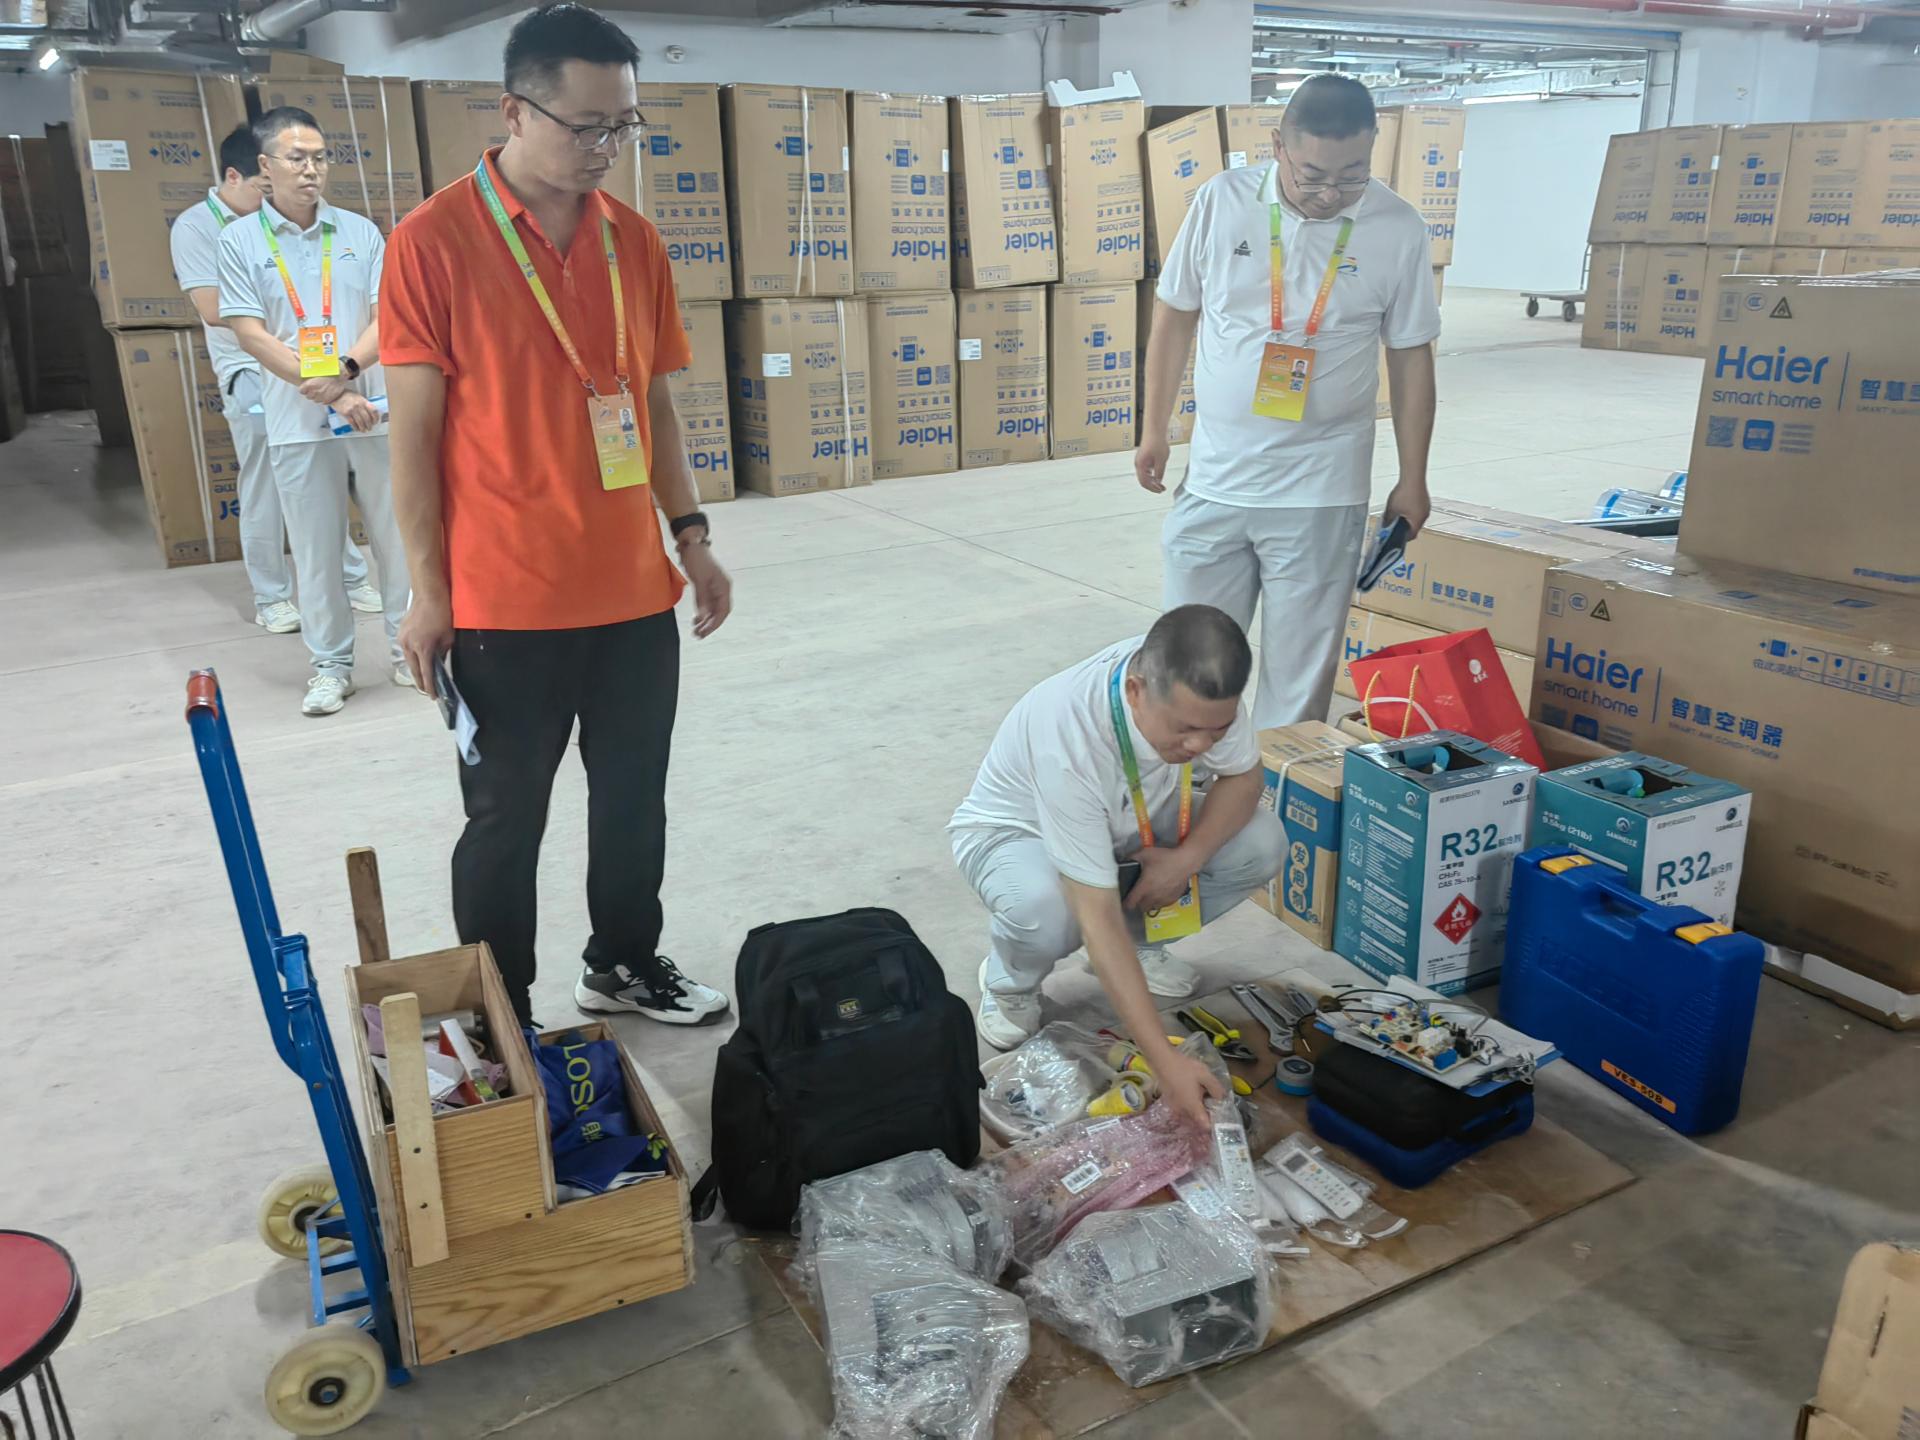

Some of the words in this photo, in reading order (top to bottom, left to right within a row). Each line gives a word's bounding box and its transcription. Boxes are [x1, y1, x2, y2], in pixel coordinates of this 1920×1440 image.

[1669, 210, 1707, 225] Haier
[1733, 211, 1775, 227] Haier
[1806, 211, 1851, 227] Haier
[667, 240, 725, 266] Haie
[891, 239, 947, 263] Haier
[1004, 229, 1056, 254] Haier
[1096, 231, 1141, 255] Haier
[1603, 320, 1637, 334] Haer
[1659, 324, 1696, 339] Haier
[1714, 344, 1831, 385] Haier
[1711, 388, 1765, 407] smart
[1766, 388, 1823, 410] home
[996, 414, 1046, 438] Haier
[1085, 405, 1132, 428] Haier
[897, 424, 953, 448] Haier
[1383, 582, 1413, 597] home
[1544, 636, 1645, 694] Haier
[1542, 679, 1588, 703] smart
[1591, 692, 1640, 718] home
[1671, 696, 1784, 749] 智慧空调器
[1440, 823, 1499, 862] R32
[1655, 850, 1712, 893] R32
